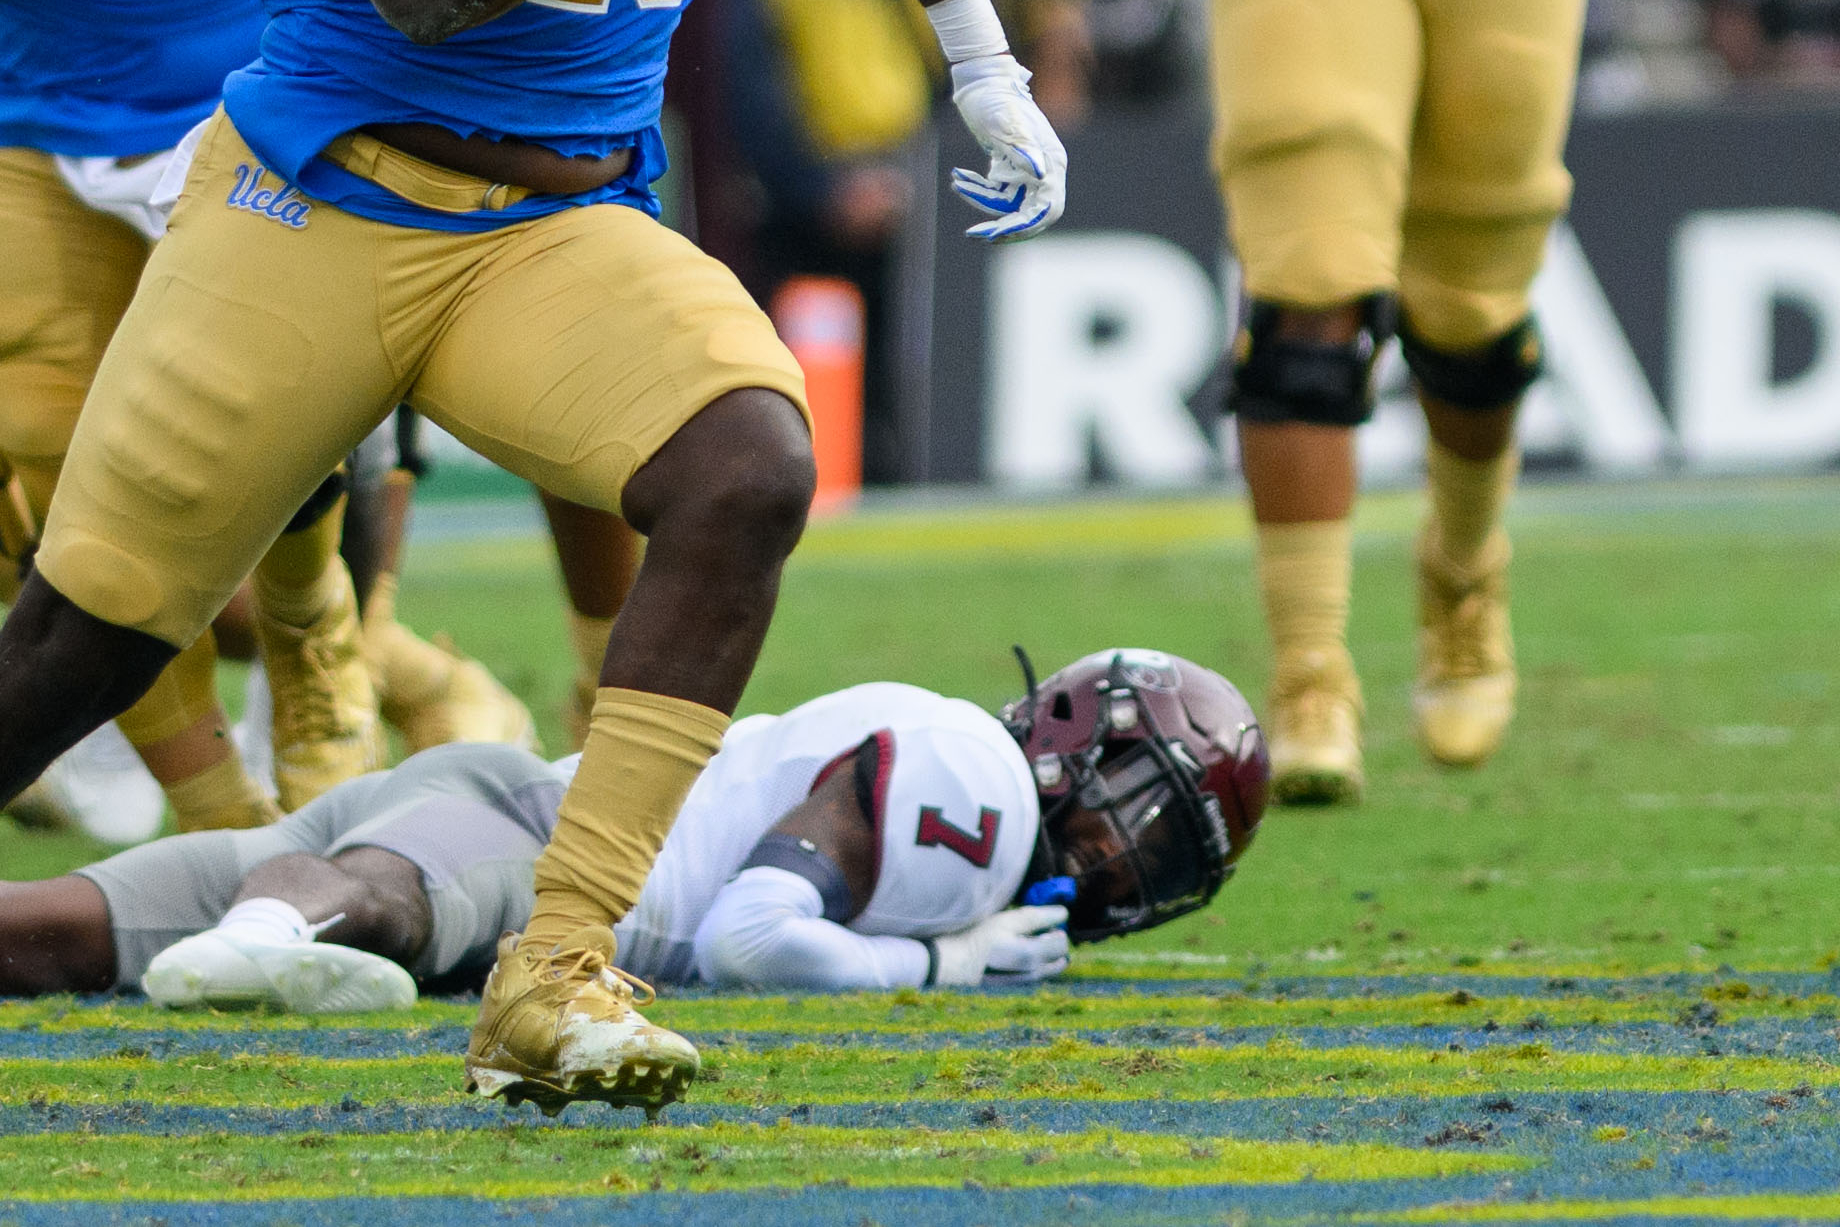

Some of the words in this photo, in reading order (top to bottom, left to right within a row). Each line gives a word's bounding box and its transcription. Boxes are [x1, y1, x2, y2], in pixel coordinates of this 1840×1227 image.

[227, 163, 311, 230] Ucla
[988, 206, 1840, 488] RAD
[916, 804, 1002, 869] 7
